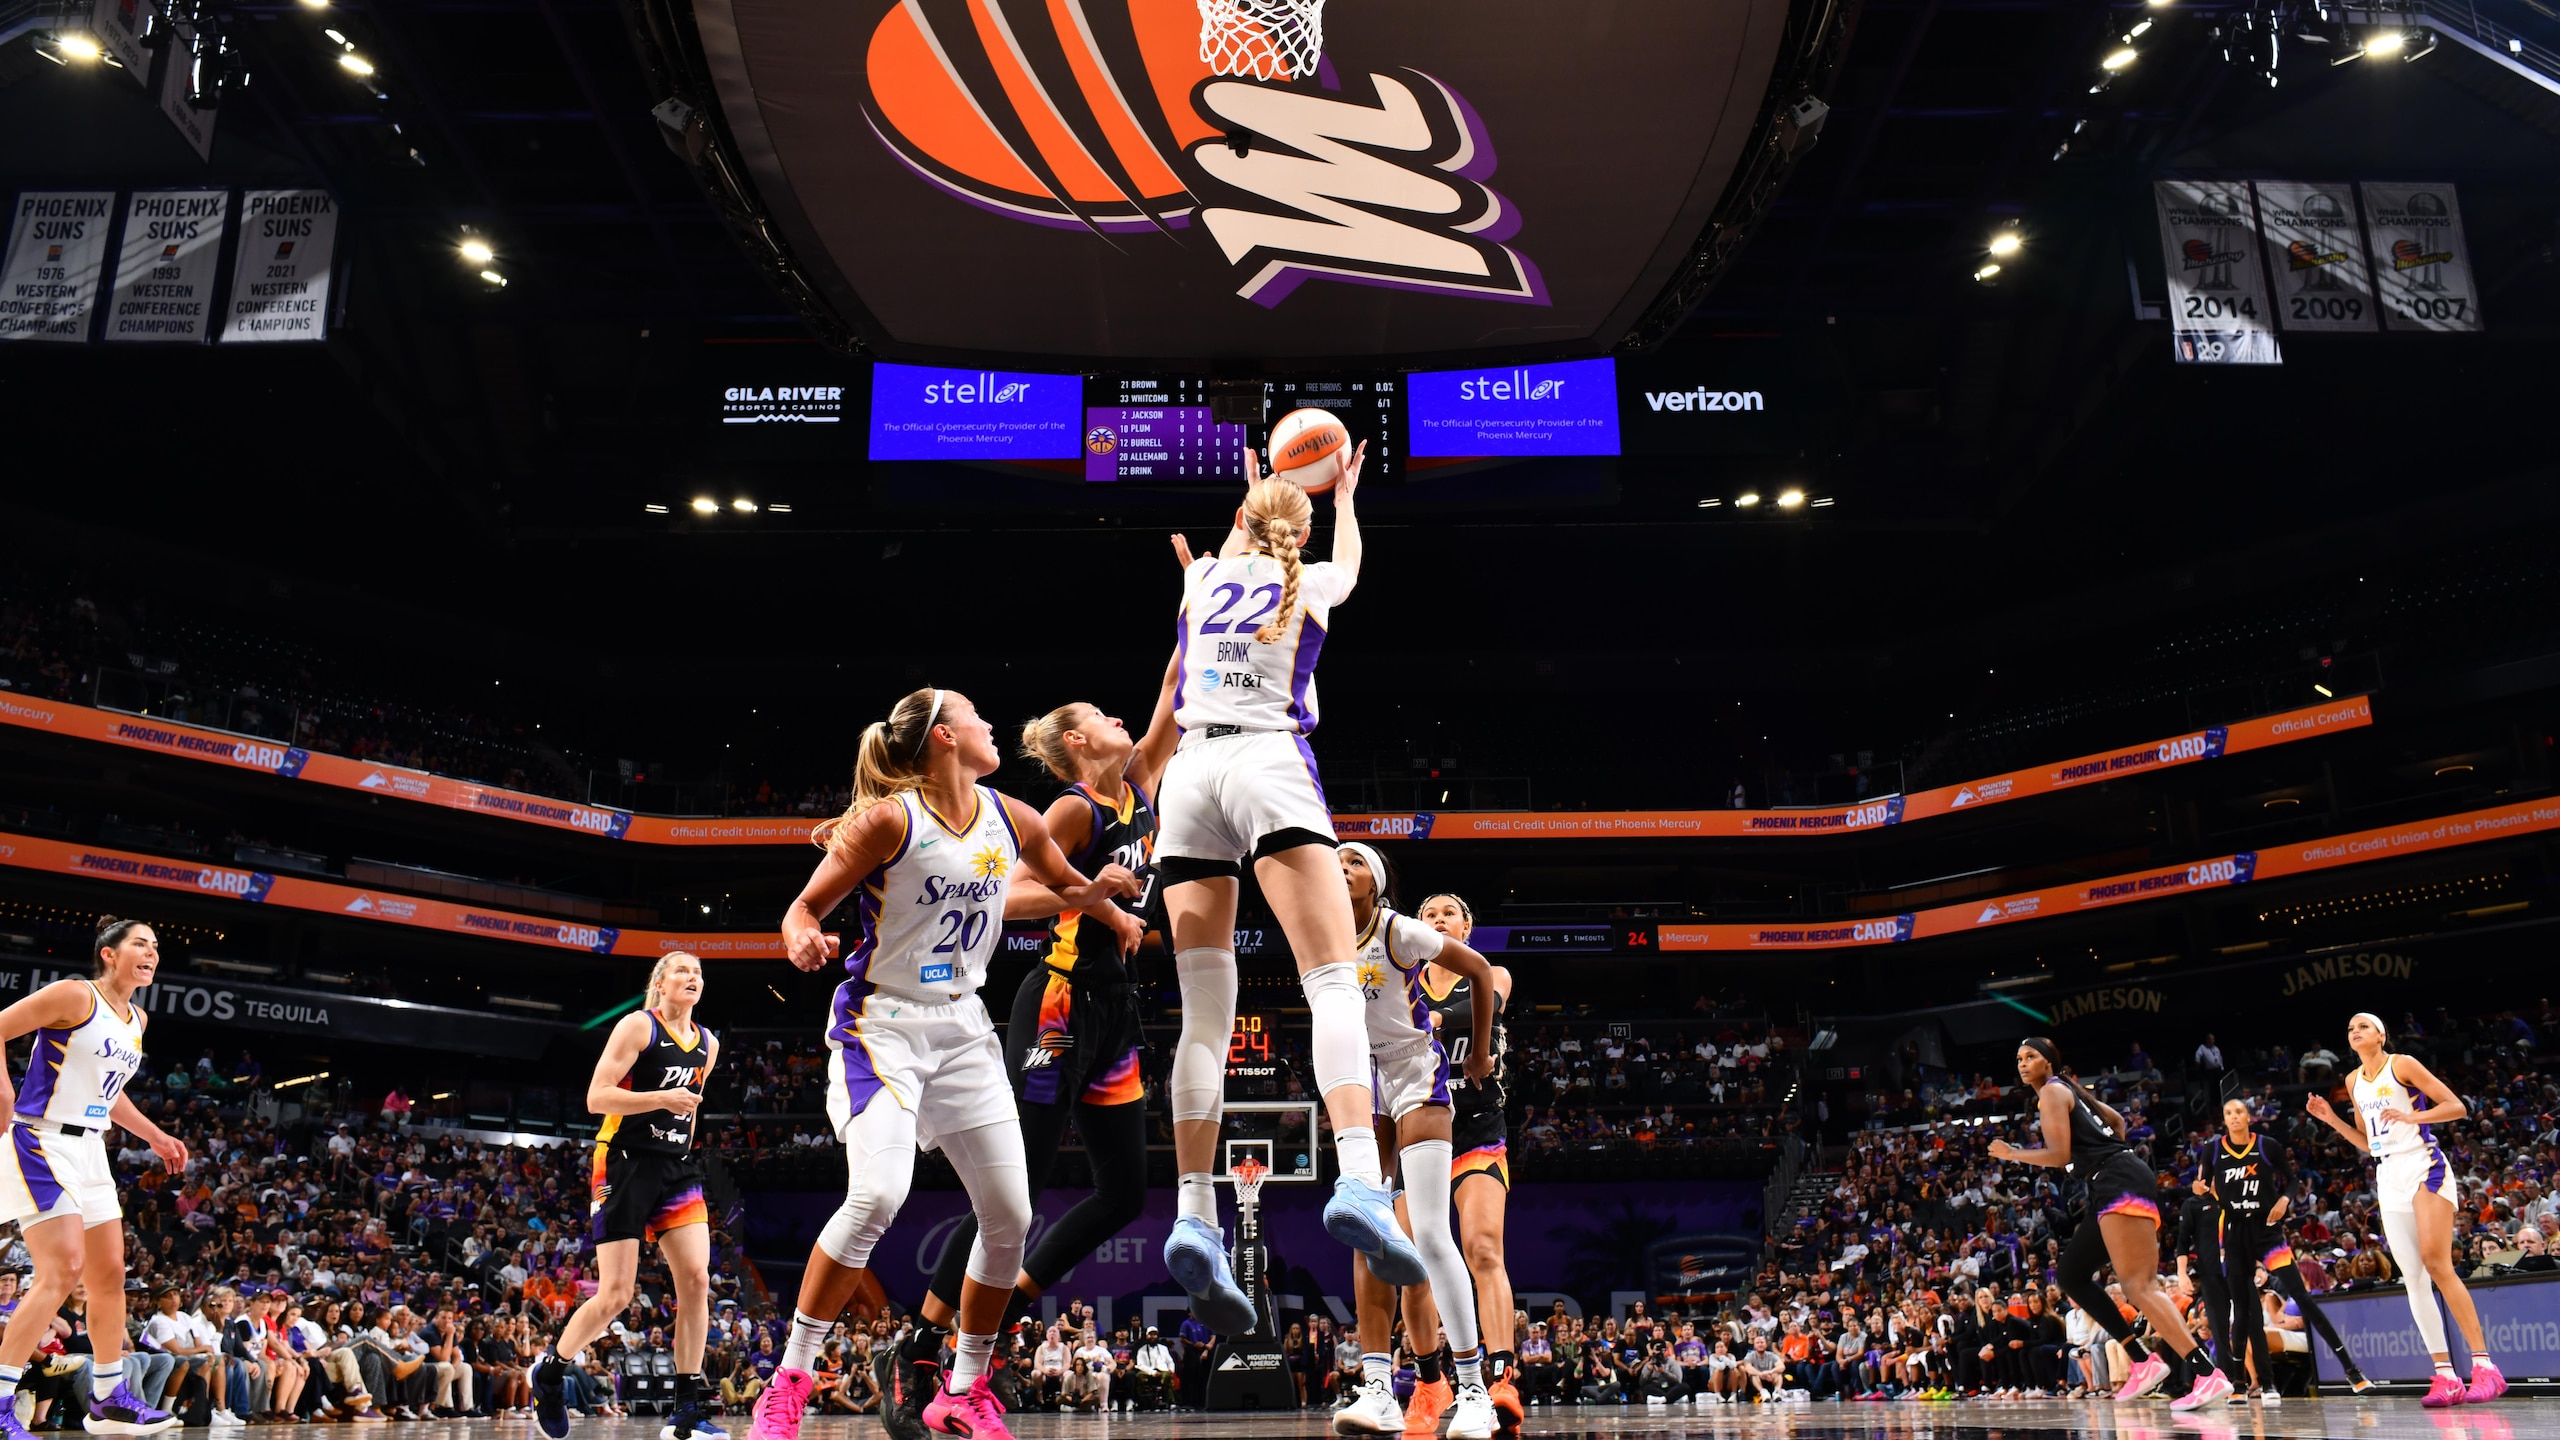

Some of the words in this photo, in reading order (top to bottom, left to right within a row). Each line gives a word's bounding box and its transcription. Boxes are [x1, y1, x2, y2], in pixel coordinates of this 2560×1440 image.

[22, 199, 108, 217] PHOENIX
[135, 199, 219, 217] PHOENIX
[251, 196, 331, 214] PHOENIX
[263, 219, 312, 237] SUNS
[2170, 217, 2243, 227] CHAMPIONS
[2274, 218, 2346, 228] CHAMPIONS
[2378, 217, 2450, 227] CHAMPIONS
[33, 222, 85, 239] SUNS
[148, 222, 199, 239] SUNS
[37, 267, 64, 280] 1976
[152, 267, 180, 280] 1993
[267, 265, 296, 278] 2021
[15, 285, 77, 297] WESTERN
[133, 285, 193, 297] WESTERN
[251, 282, 308, 295] WESTERN
[0, 301, 84, 316] CONFERENCE
[119, 302, 201, 315] CONFERENCE
[236, 300, 317, 313] CONFERENCE
[2186, 297, 2257, 319] 2014
[2291, 298, 2363, 320] 2009
[0, 319, 77, 334] CHAMPIONS
[119, 320, 194, 333] CHAMPIONS
[238, 317, 310, 331] CHAMPIONS
[725, 387, 774, 401] GILA
[778, 387, 841, 400] RIVER
[1306, 383, 1318, 391] FREE
[1320, 383, 1342, 391] THROWS
[1376, 383, 1393, 392] 0.0%
[1296, 399, 1352, 407] REBOUNDS/OFFENSIVE
[1378, 399, 1390, 407] 6/1
[1645, 386, 1763, 411] verizon
[1122, 411, 1126, 419] 2
[1131, 411, 1163, 419] JACKSON
[884, 423, 900, 431] The
[903, 422, 933, 431] Official
[936, 422, 997, 433] Cybersecurity
[999, 422, 1036, 430] Provider
[1051, 422, 1065, 430] the
[1442, 419, 1472, 427] Official
[1475, 419, 1535, 429] Cybersecurity
[1538, 418, 1575, 427] Provider
[1589, 418, 1603, 426] the
[937, 434, 973, 443] Phoenix
[976, 434, 1013, 444] Mercury
[1477, 431, 1513, 439] Phoenix
[1515, 430, 1553, 440] Mercury
[1120, 439, 1128, 447] 12
[1131, 439, 1162, 447] BURRELL
[1288, 431, 1338, 458] Wilson
[1119, 467, 1127, 475] 22
[1130, 467, 1152, 475] BRINK
[1200, 583, 1283, 635] 22
[1217, 642, 1251, 662] BRINK
[1224, 673, 1264, 688] AT&T
[2272, 717, 2314, 735] Official
[2318, 709, 2355, 725] Credit
[119, 724, 176, 745] PHOENIX
[177, 736, 236, 756] MERCURY
[233, 743, 284, 770] CARD
[2062, 760, 2107, 780] PHOENIX
[2111, 749, 2161, 770] MERCURY
[2158, 736, 2206, 762] CARD
[393, 775, 430, 788] MOUNTAIN
[1978, 780, 2012, 792] MOUNTAIN
[478, 794, 525, 812] PHOENIX
[526, 804, 573, 821] MERCURY
[571, 809, 612, 832] CARD
[1753, 817, 1798, 828] PHOENIX
[1799, 815, 1848, 828] MERCURY
[1846, 805, 1888, 828] CARD
[671, 827, 708, 837] Official
[711, 827, 743, 837] Credit
[746, 827, 776, 836] Union
[796, 826, 810, 836] the
[1370, 817, 1414, 835] CARD
[1474, 820, 1510, 830] Official
[1513, 820, 1545, 830] Credit
[1549, 819, 1578, 829] Union
[1582, 819, 1595, 829] of
[1598, 819, 1611, 829] the
[1615, 819, 1655, 829] Phoenix
[1659, 819, 1701, 830] Mercury
[2303, 845, 2345, 861] Official
[2349, 837, 2387, 854] Credit
[2391, 830, 2429, 846] Union
[2450, 822, 2471, 836] the
[2475, 814, 2529, 832] Phoenix
[81, 854, 139, 873] PHOENIX
[143, 864, 202, 882] MERCURY
[198, 869, 250, 894] CARD
[2089, 882, 2136, 900] PHOENIX
[2139, 872, 2190, 891] MERCURY
[2187, 860, 2236, 884] CARD
[916, 875, 1001, 906] SPARKS
[378, 899, 417, 911] MOUNTAIN
[2004, 898, 2040, 909] MOUNTAIN
[465, 914, 511, 932] PHOENIX
[512, 921, 560, 938] MERCURY
[557, 925, 599, 948] CARD
[932, 910, 988, 953] 20
[1629, 932, 1648, 945] 24
[1666, 933, 1709, 944] Mercury
[1760, 931, 1804, 942] PHOENIX
[1807, 928, 1856, 941] MERCURY
[1853, 921, 1898, 941] CARD
[660, 940, 697, 950] Official
[700, 941, 732, 950] Credit
[736, 941, 765, 950] Union
[769, 940, 782, 950] of
[925, 968, 948, 980] UCLA
[2282, 953, 2413, 997] JAMESON
[246, 1000, 329, 1025] TEQUILA
[2047, 988, 2163, 1027] JAMESON
[1613, 1027, 1626, 1036] 121
[1229, 1033, 1269, 1062] 24
[1450, 1037, 1468, 1064] 0
[659, 1066, 704, 1087] PHX
[1237, 1067, 1276, 1076] TISSOT
[99, 1071, 122, 1100] 10
[88, 1108, 107, 1116] UCLA
[2225, 1163, 2258, 1183] PHX
[2242, 1180, 2259, 1196] 14
[1096, 1239, 1147, 1263] BET
[1244, 1247, 1254, 1281] Health
